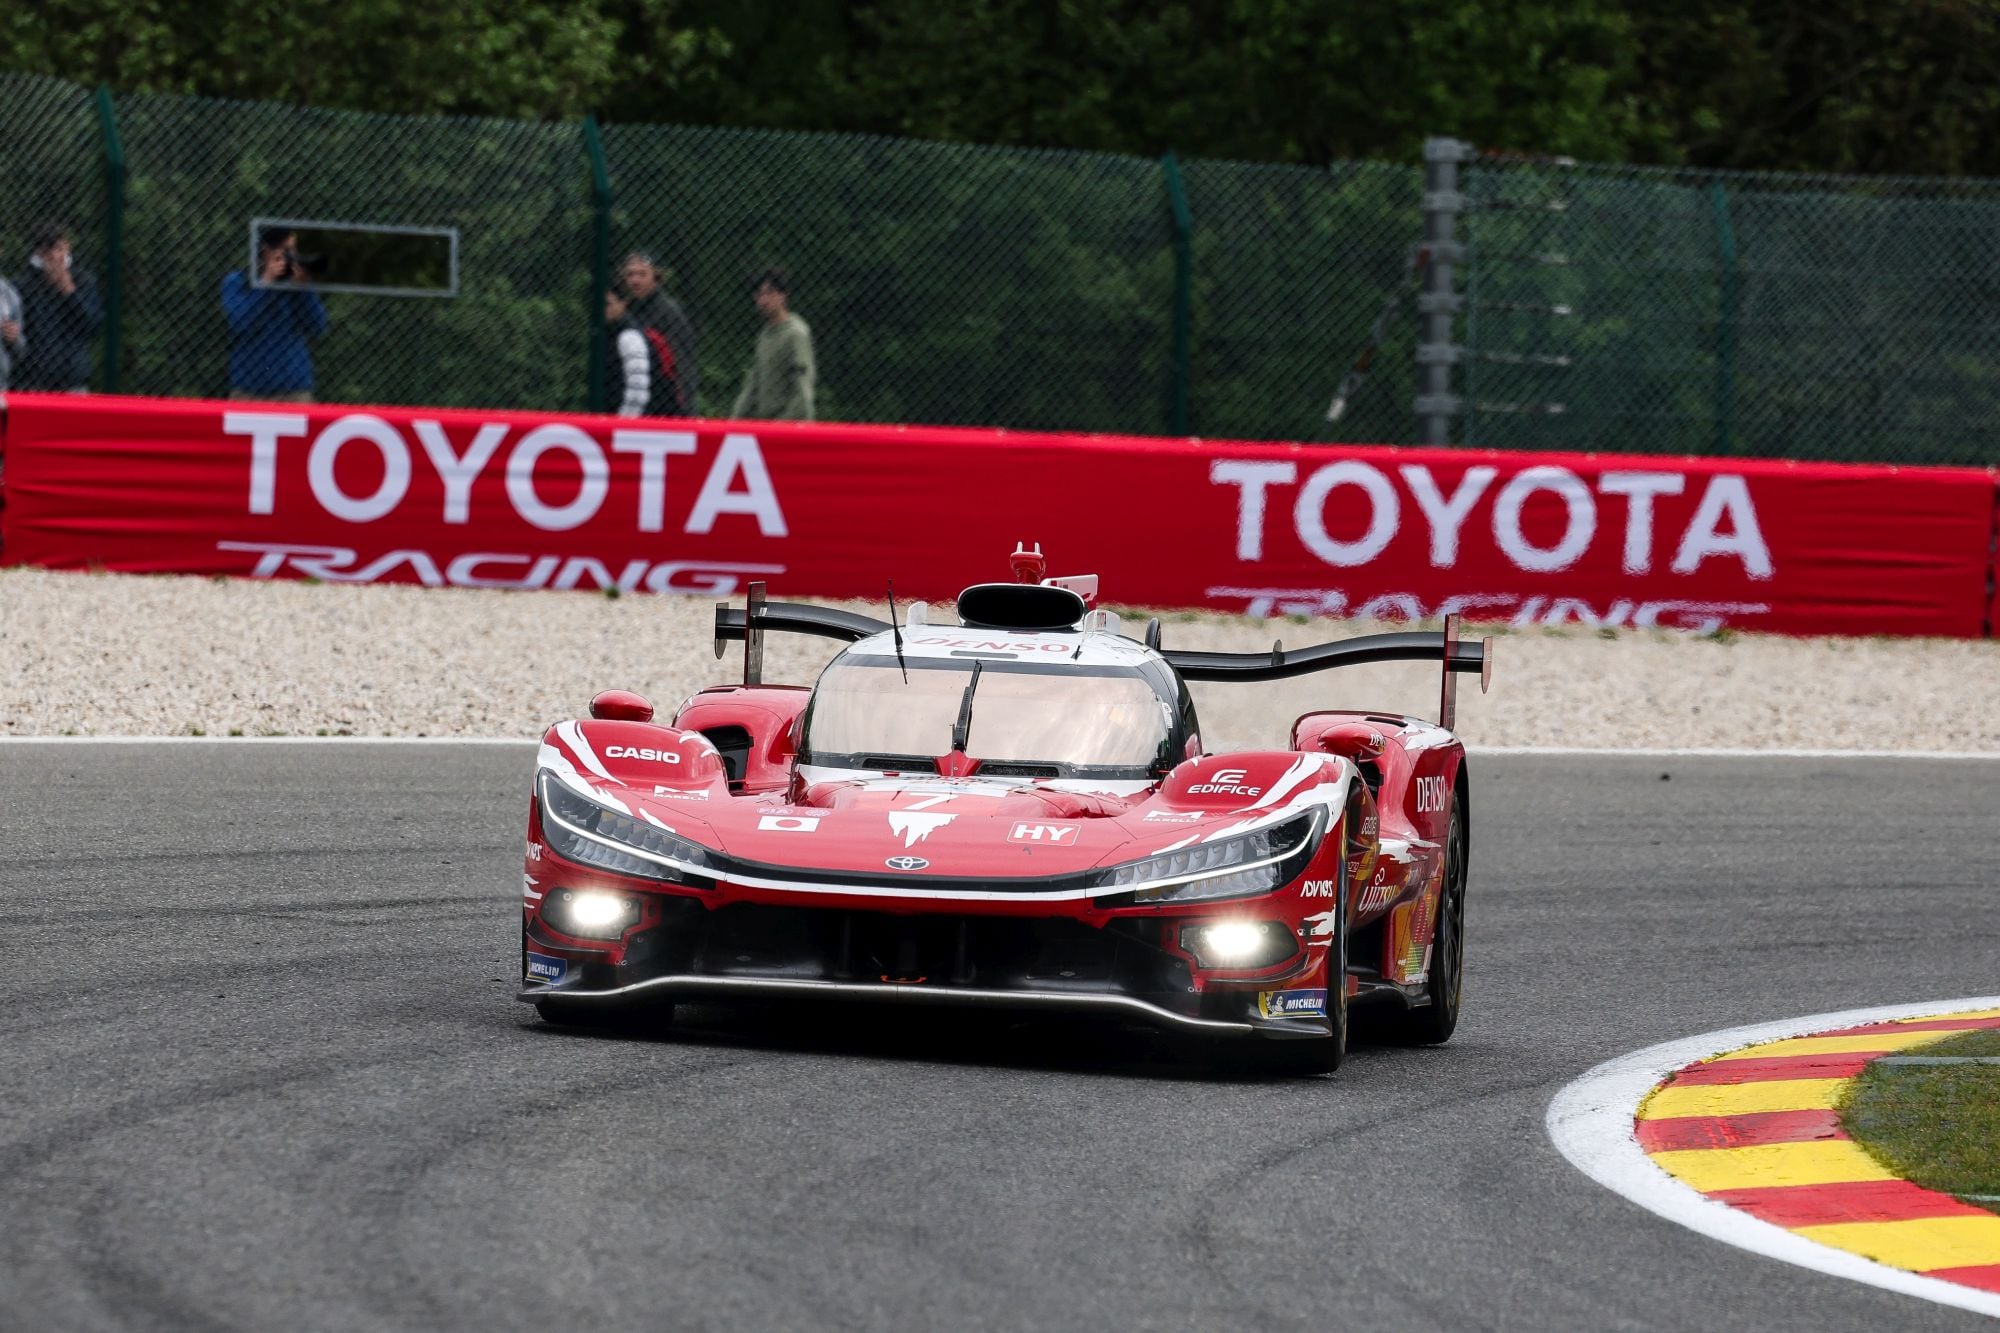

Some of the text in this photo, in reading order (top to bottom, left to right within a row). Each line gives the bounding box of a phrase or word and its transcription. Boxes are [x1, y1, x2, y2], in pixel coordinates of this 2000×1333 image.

[222, 412, 789, 537] TOYOTA
[1209, 459, 1775, 582] TOYOTA
[217, 541, 787, 595] RACING
[911, 637, 1070, 652] DENSO
[605, 745, 681, 764] CASIO
[1187, 784, 1262, 797] EDIFICE
[1416, 775, 1446, 813] DENSO
[1013, 824, 1075, 841] HY
[1285, 998, 1324, 1010] MICHELIN
